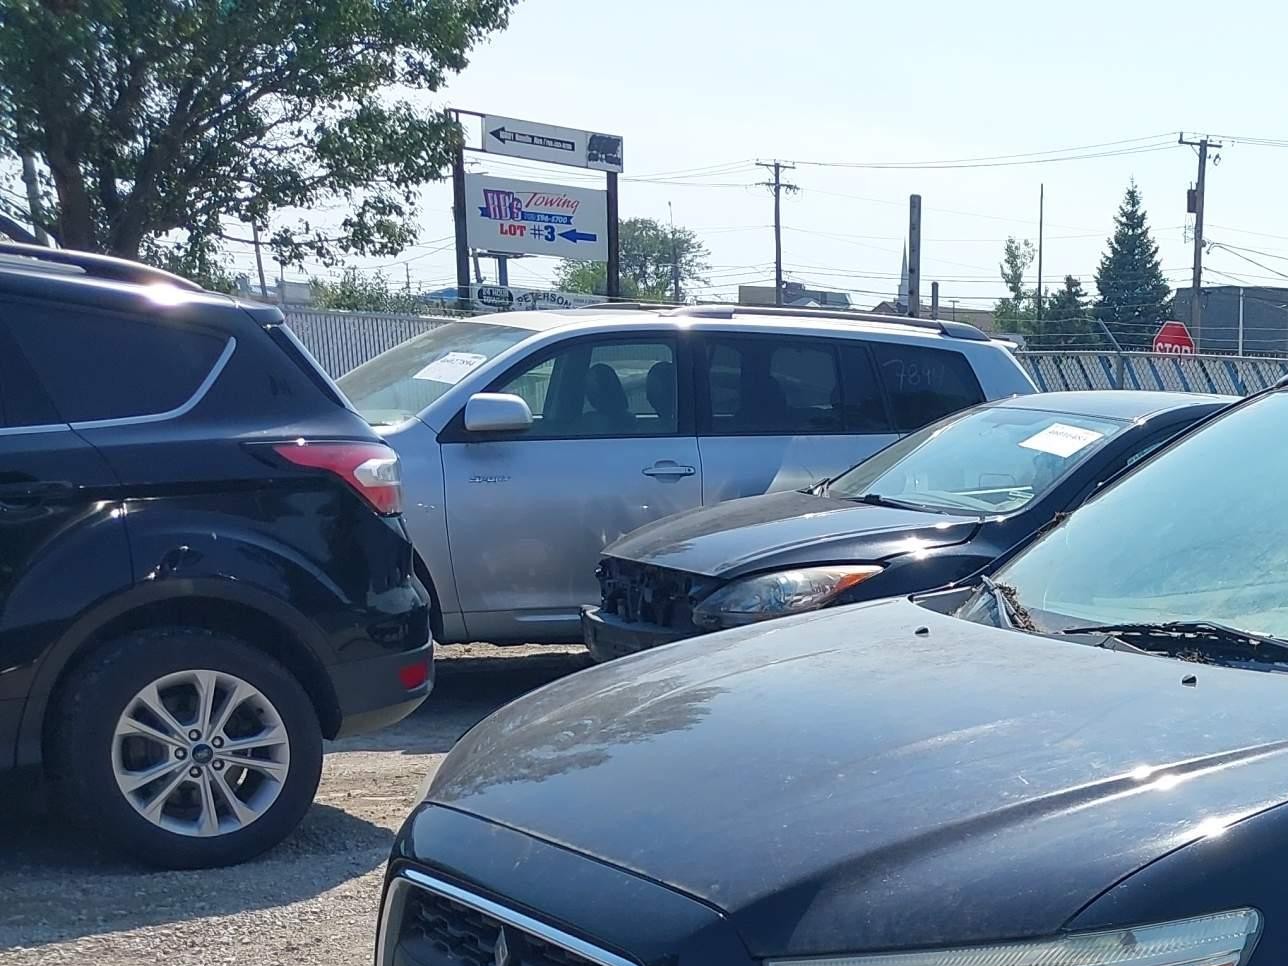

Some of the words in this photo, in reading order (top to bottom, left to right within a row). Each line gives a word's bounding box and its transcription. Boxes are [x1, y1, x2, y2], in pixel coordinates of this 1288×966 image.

[518, 192, 580, 214] Towing
[500, 223, 527, 237] LOT
[530, 224, 556, 242] #3
